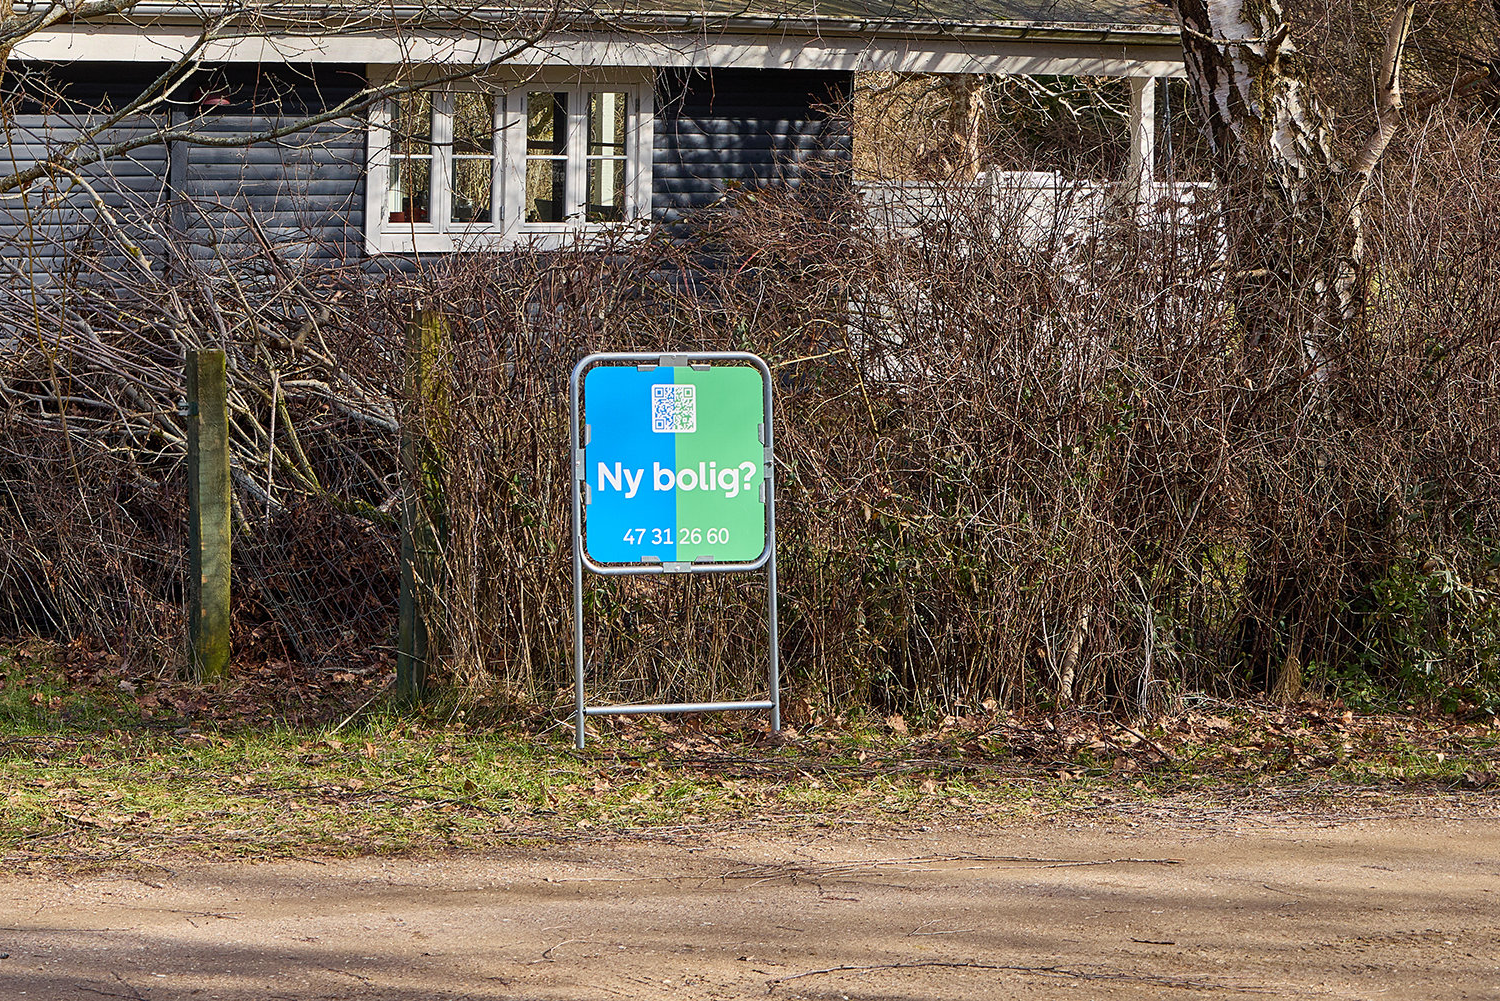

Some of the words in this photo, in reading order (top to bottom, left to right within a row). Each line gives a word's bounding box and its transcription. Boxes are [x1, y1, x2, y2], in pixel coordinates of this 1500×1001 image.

[597, 462, 645, 499] Ny
[653, 461, 757, 499] bolig?
[623, 528, 646, 545] 47
[651, 528, 674, 545] 31
[679, 528, 702, 545] 26
[706, 528, 730, 545] 60
